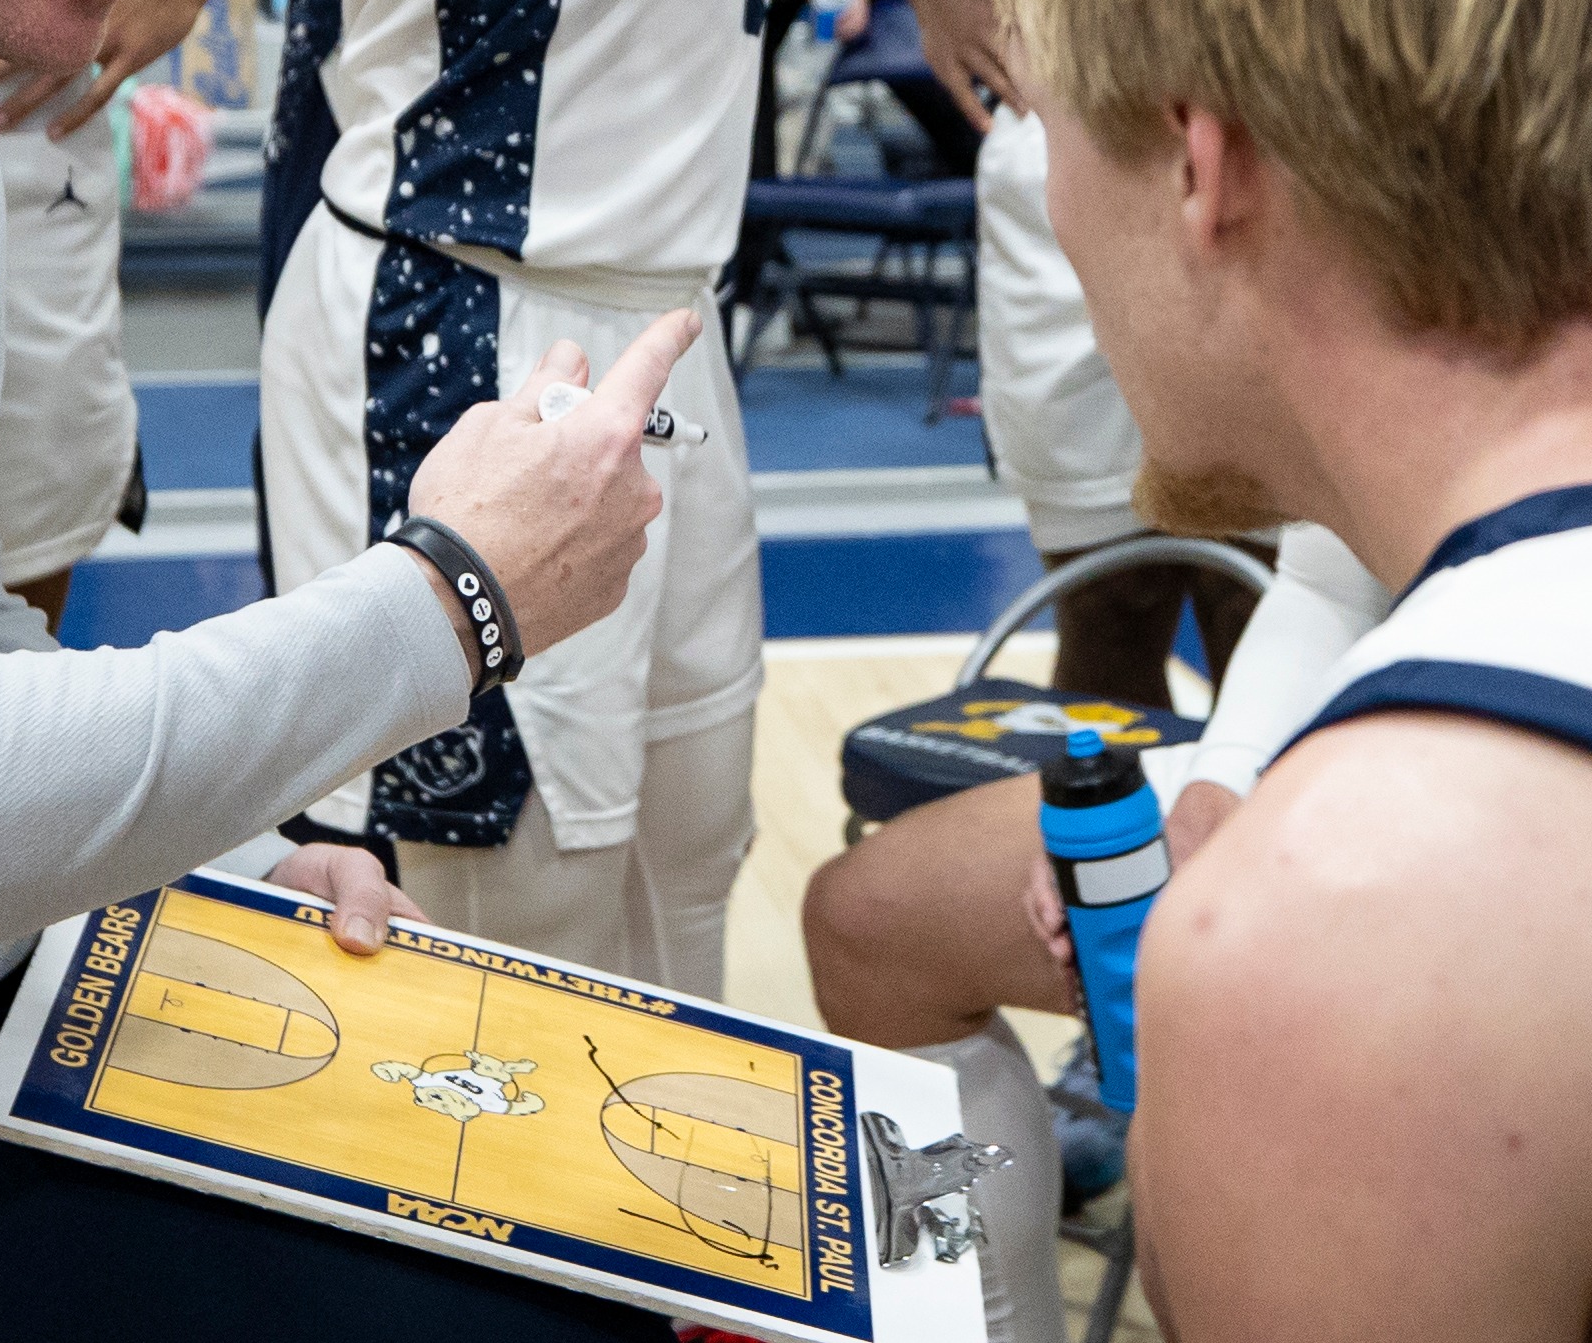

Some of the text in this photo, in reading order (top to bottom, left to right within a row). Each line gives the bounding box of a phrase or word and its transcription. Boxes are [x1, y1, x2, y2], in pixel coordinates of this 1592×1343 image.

[50, 904, 142, 1068] GOLDEN BEARS
[387, 1191, 515, 1243] NCAA
[810, 1068, 855, 1293] CONCORDIA ST. PAUL
